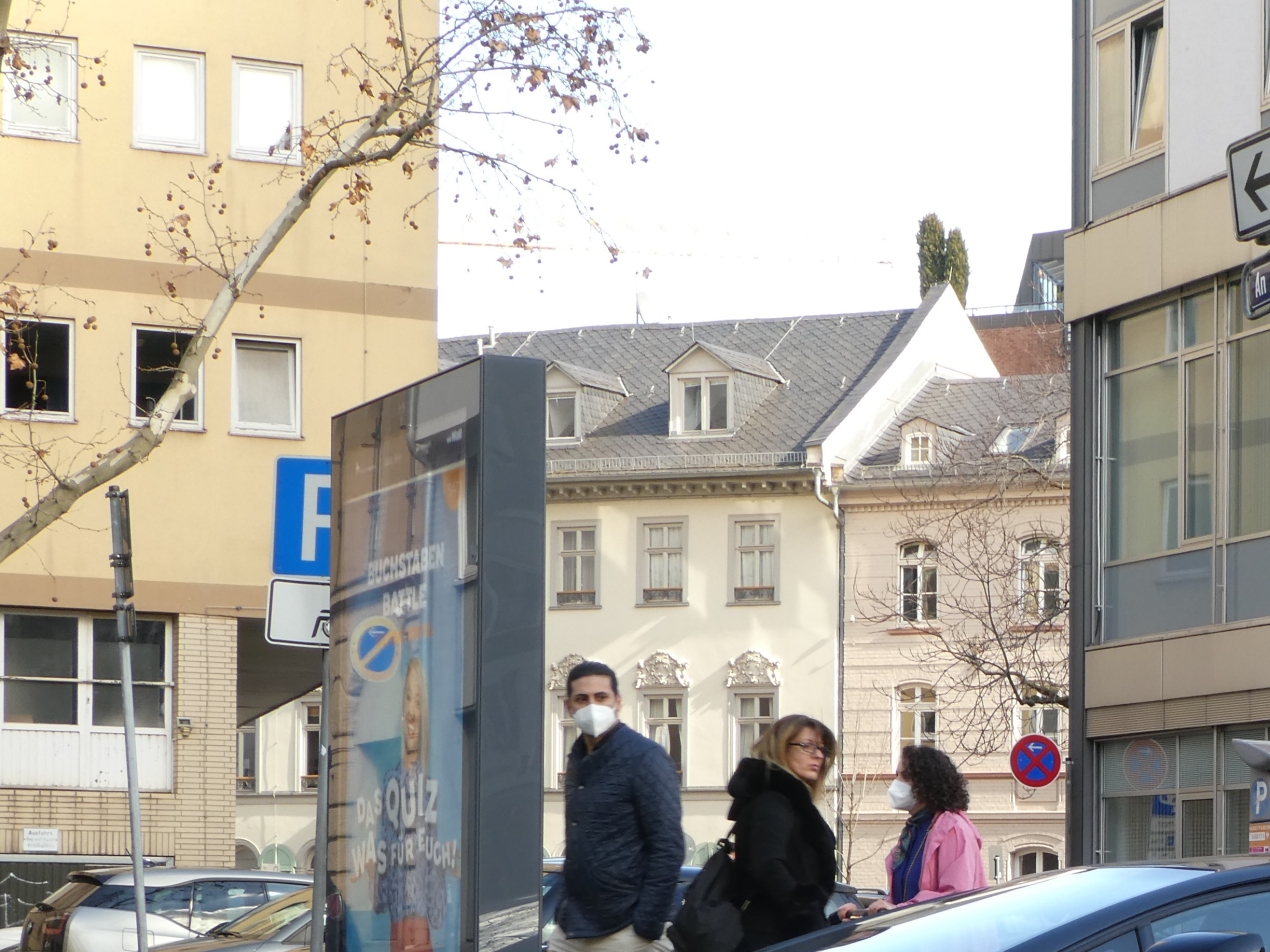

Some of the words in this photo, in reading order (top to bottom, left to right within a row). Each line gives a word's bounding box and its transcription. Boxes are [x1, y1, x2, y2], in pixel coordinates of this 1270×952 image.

[1255, 272, 1267, 298] An
[368, 542, 444, 586] BUCHSTABEN
[356, 787, 382, 829] DAS
[386, 772, 438, 830] QUIZ
[1256, 780, 1268, 815] P
[351, 830, 387, 878] WAS
[390, 834, 415, 867] FÜR
[418, 827, 457, 870] EUCH!
